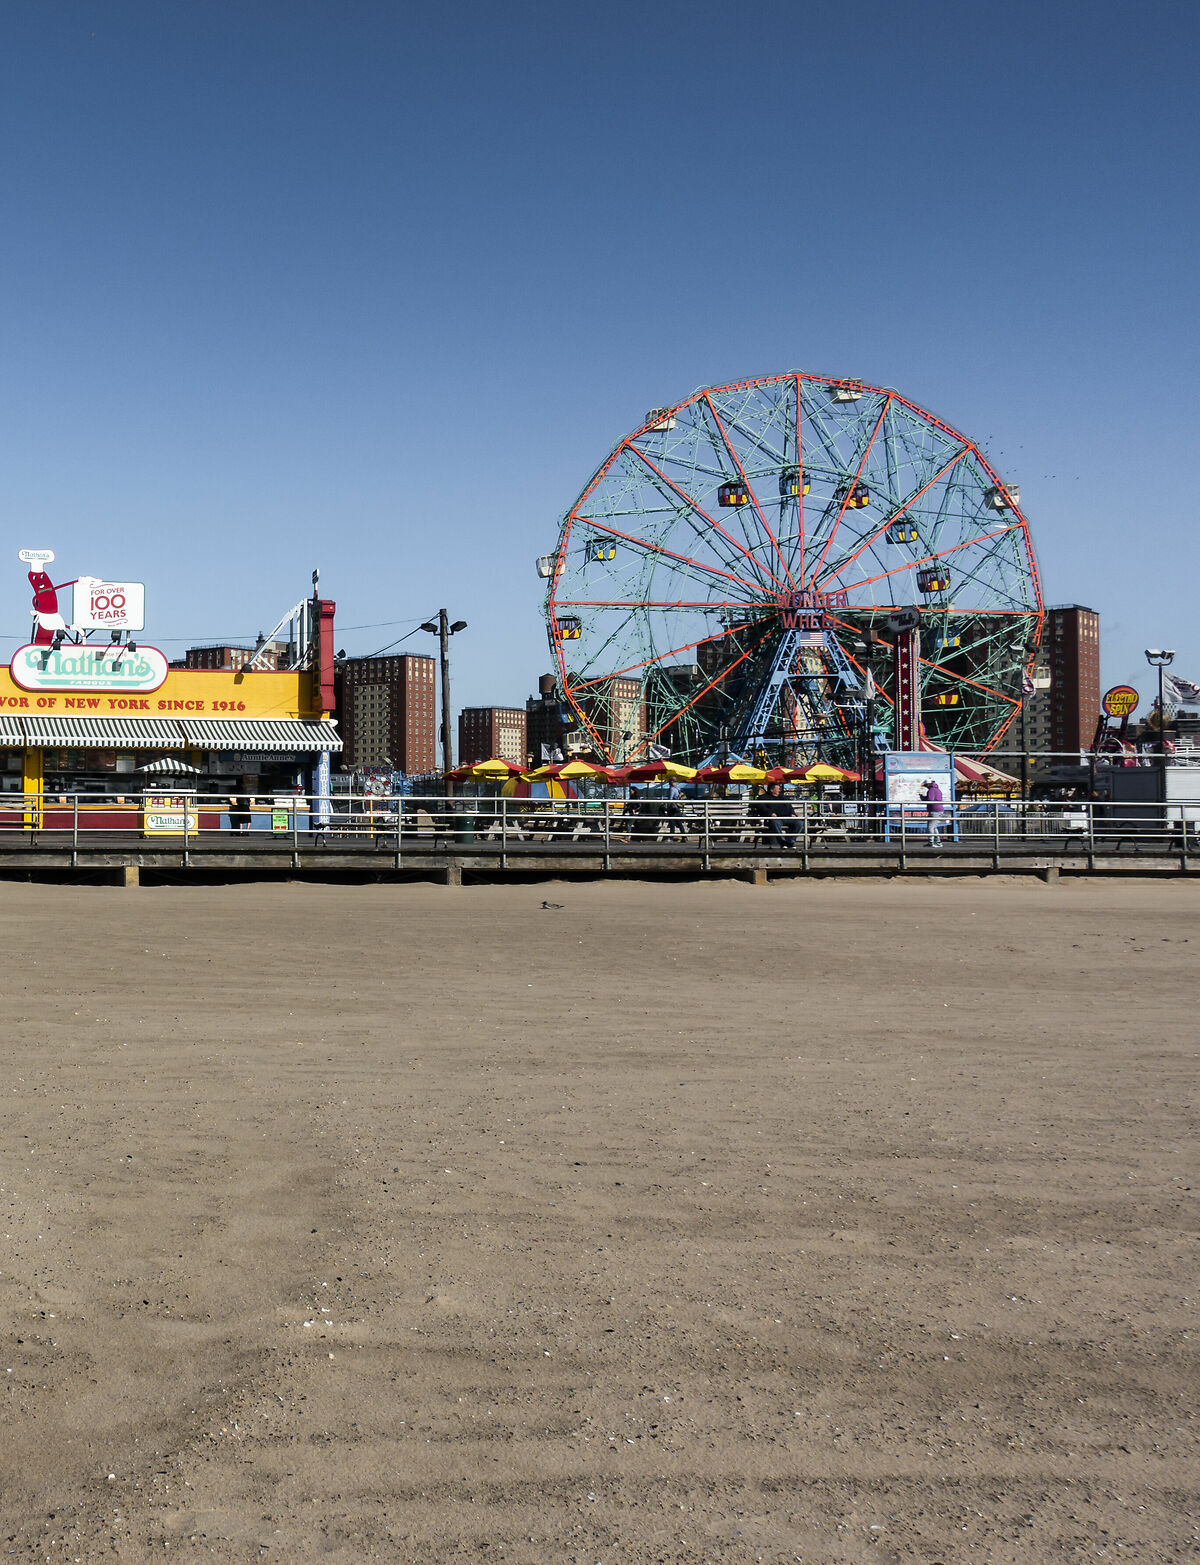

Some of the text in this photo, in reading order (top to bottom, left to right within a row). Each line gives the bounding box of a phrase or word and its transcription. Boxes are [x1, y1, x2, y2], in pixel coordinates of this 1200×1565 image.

[90, 594, 126, 611] 100
[777, 592, 847, 608] WONDER
[90, 610, 126, 620] YEARS
[782, 613, 843, 628] WHEEL
[25, 648, 152, 679] Nathan's
[36, 698, 57, 708] OF
[65, 698, 101, 709] NEW
[108, 699, 150, 710] YORK
[158, 700, 205, 711] SINCE
[211, 701, 246, 711] 1916
[1105, 693, 1139, 704] ELECTRO
[1110, 704, 1130, 715] SPIN
